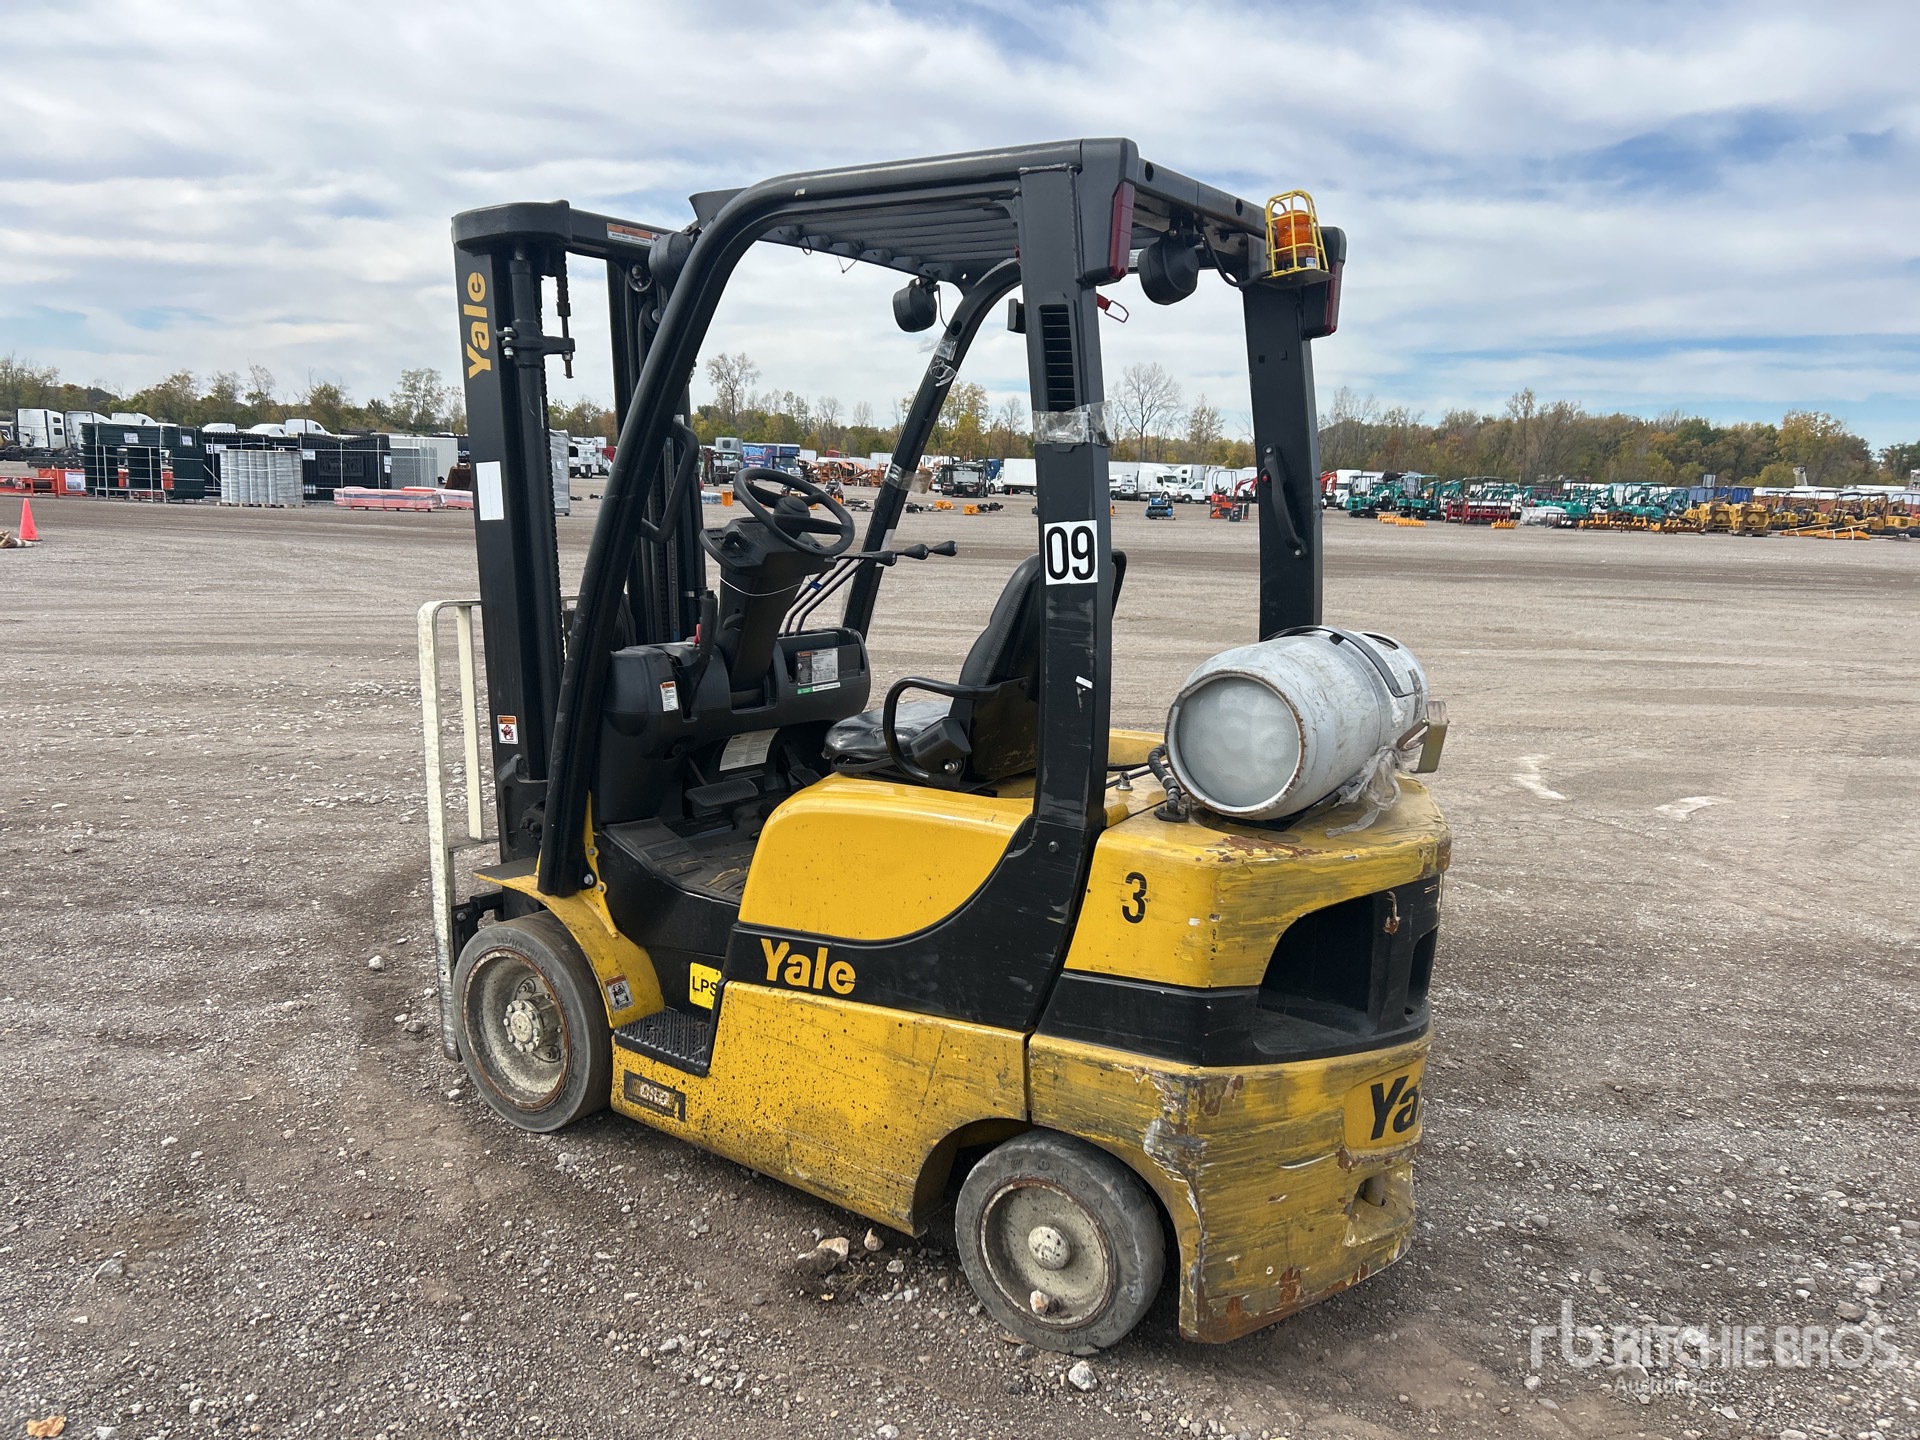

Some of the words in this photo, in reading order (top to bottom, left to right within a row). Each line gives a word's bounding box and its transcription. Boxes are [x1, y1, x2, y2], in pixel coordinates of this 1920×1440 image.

[464, 272, 491, 379] Yale
[1045, 525, 1096, 581] 09
[1121, 871, 1148, 924] 3
[760, 937, 857, 995] Yale
